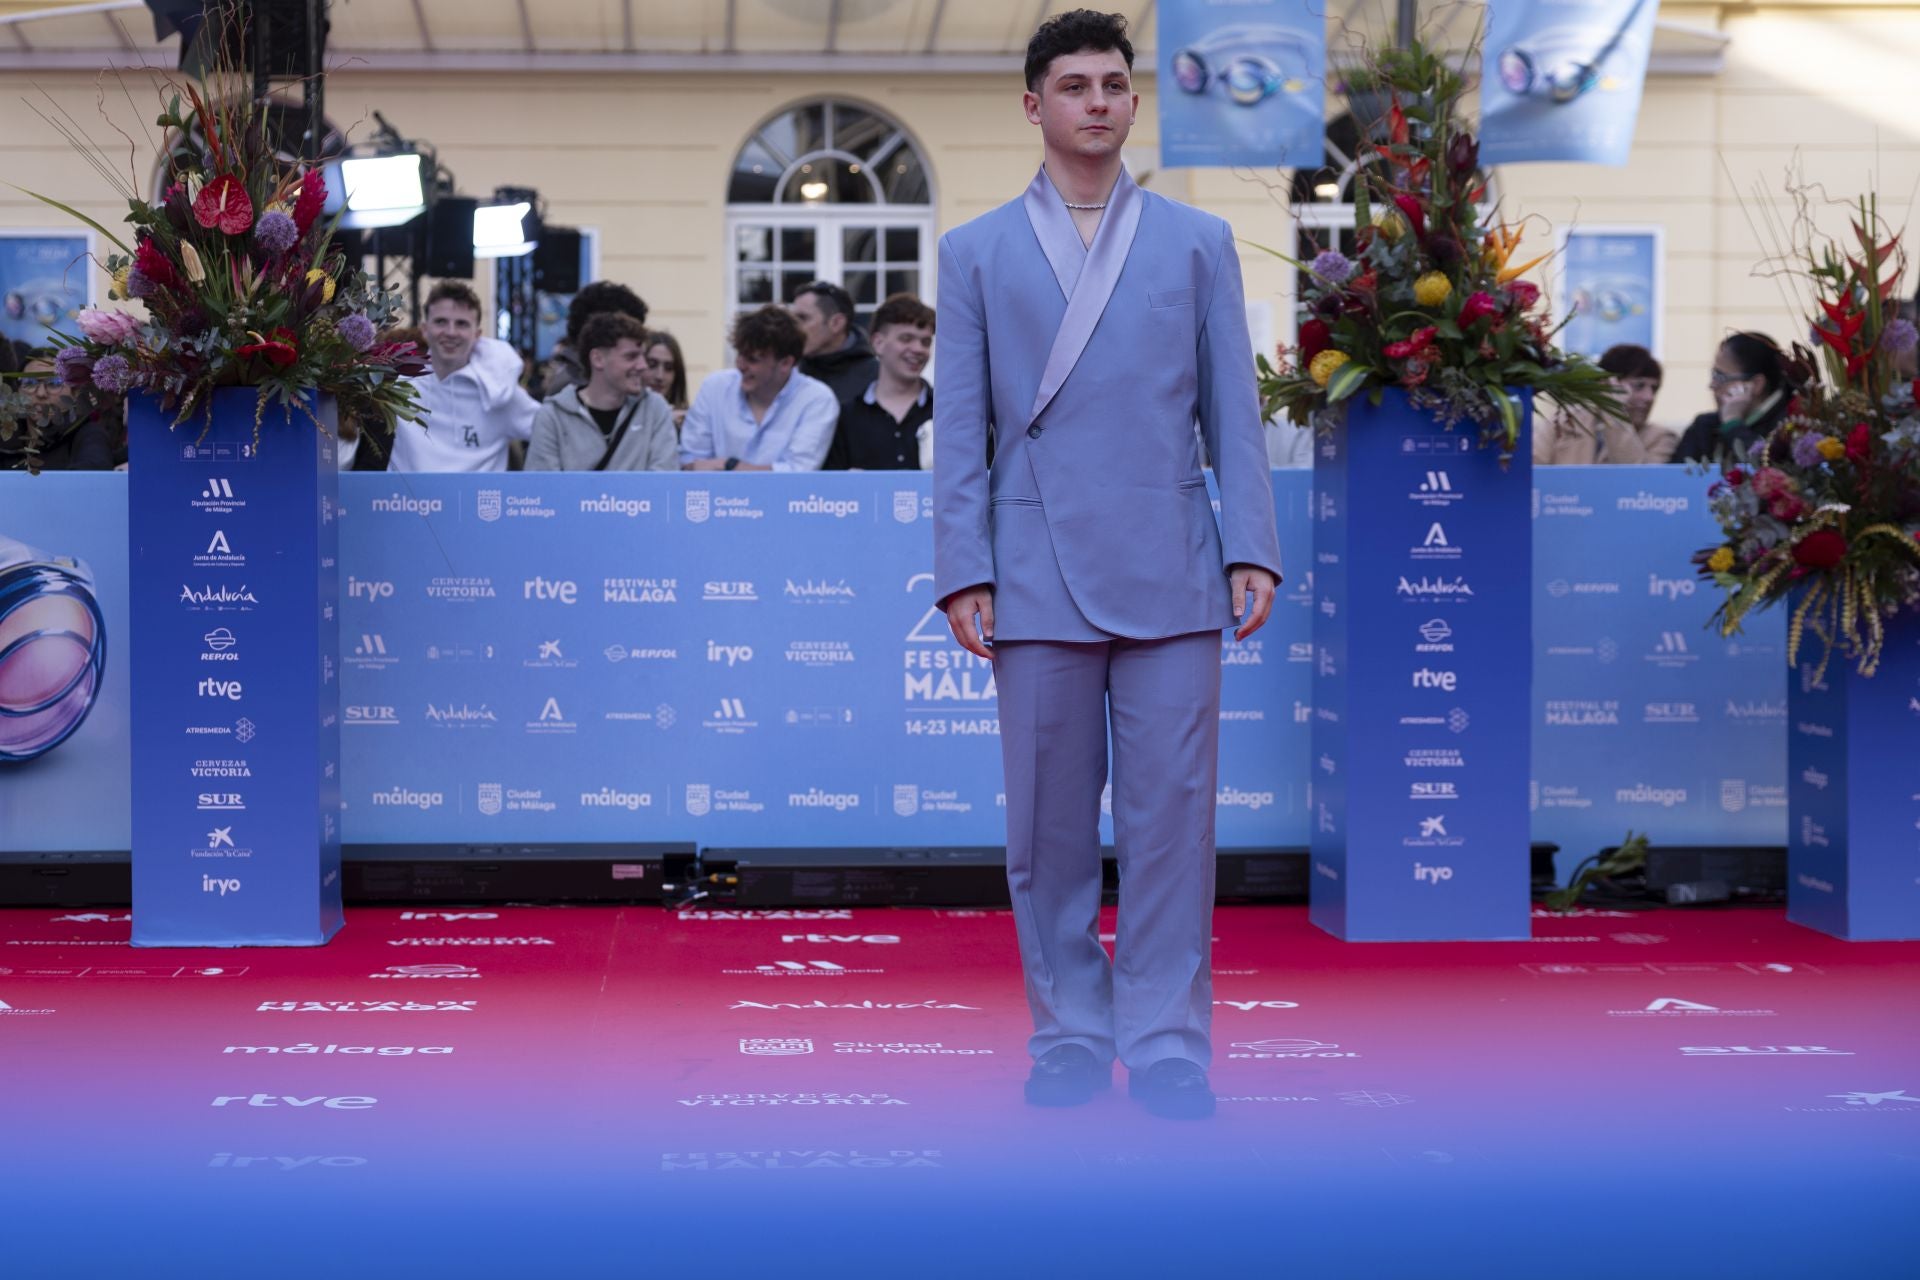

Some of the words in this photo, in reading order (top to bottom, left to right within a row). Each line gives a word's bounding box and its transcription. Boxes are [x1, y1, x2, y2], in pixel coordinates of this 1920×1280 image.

[506, 495, 541, 505] Ciudad
[714, 497, 749, 507] Ciudad
[506, 507, 519, 517] de
[520, 506, 555, 518] Málaga
[714, 508, 727, 518] de
[728, 507, 763, 519] Málaga
[432, 577, 491, 585] CERVEZAS
[604, 578, 658, 588] FESTIVAL
[662, 578, 677, 588] DE
[348, 576, 394, 602] iryo
[426, 586, 496, 597] VICTORIA
[524, 575, 577, 604] rtve
[704, 582, 755, 595] SUR
[1649, 574, 1696, 600] iryo
[179, 584, 259, 604] Andalucía
[790, 641, 849, 649] CERVEZAS
[631, 649, 677, 658] REPSOL
[707, 640, 753, 666] iryo
[784, 651, 855, 662] VICTORIA
[905, 667, 998, 700] MÁLA
[1412, 668, 1457, 691] rtve
[198, 677, 242, 700] rtve
[345, 706, 396, 719] SUR
[905, 719, 947, 735] 14-23
[951, 719, 1001, 735] MARZ
[1404, 757, 1464, 766] VICTORIA
[191, 768, 251, 776] VICTORIA
[507, 789, 541, 799] Ciudad
[1410, 783, 1455, 794] SUR
[198, 793, 243, 805] SUR
[715, 790, 749, 800] Ciudad
[922, 791, 957, 800] Ciudad
[507, 801, 520, 810] de
[521, 800, 556, 811] Málaga
[715, 801, 727, 811] de
[729, 801, 764, 812] Málaga
[922, 802, 935, 811] de
[936, 802, 971, 812] Málaga
[1414, 863, 1453, 884] iryo
[202, 874, 241, 896] iryo
[781, 934, 900, 944] rtve
[728, 1000, 982, 1010] Andalucía
[222, 1043, 454, 1056] málaga
[211, 1093, 378, 1109] rtve
[677, 1098, 911, 1106] VICTORIA
[208, 1153, 368, 1171] iryo
